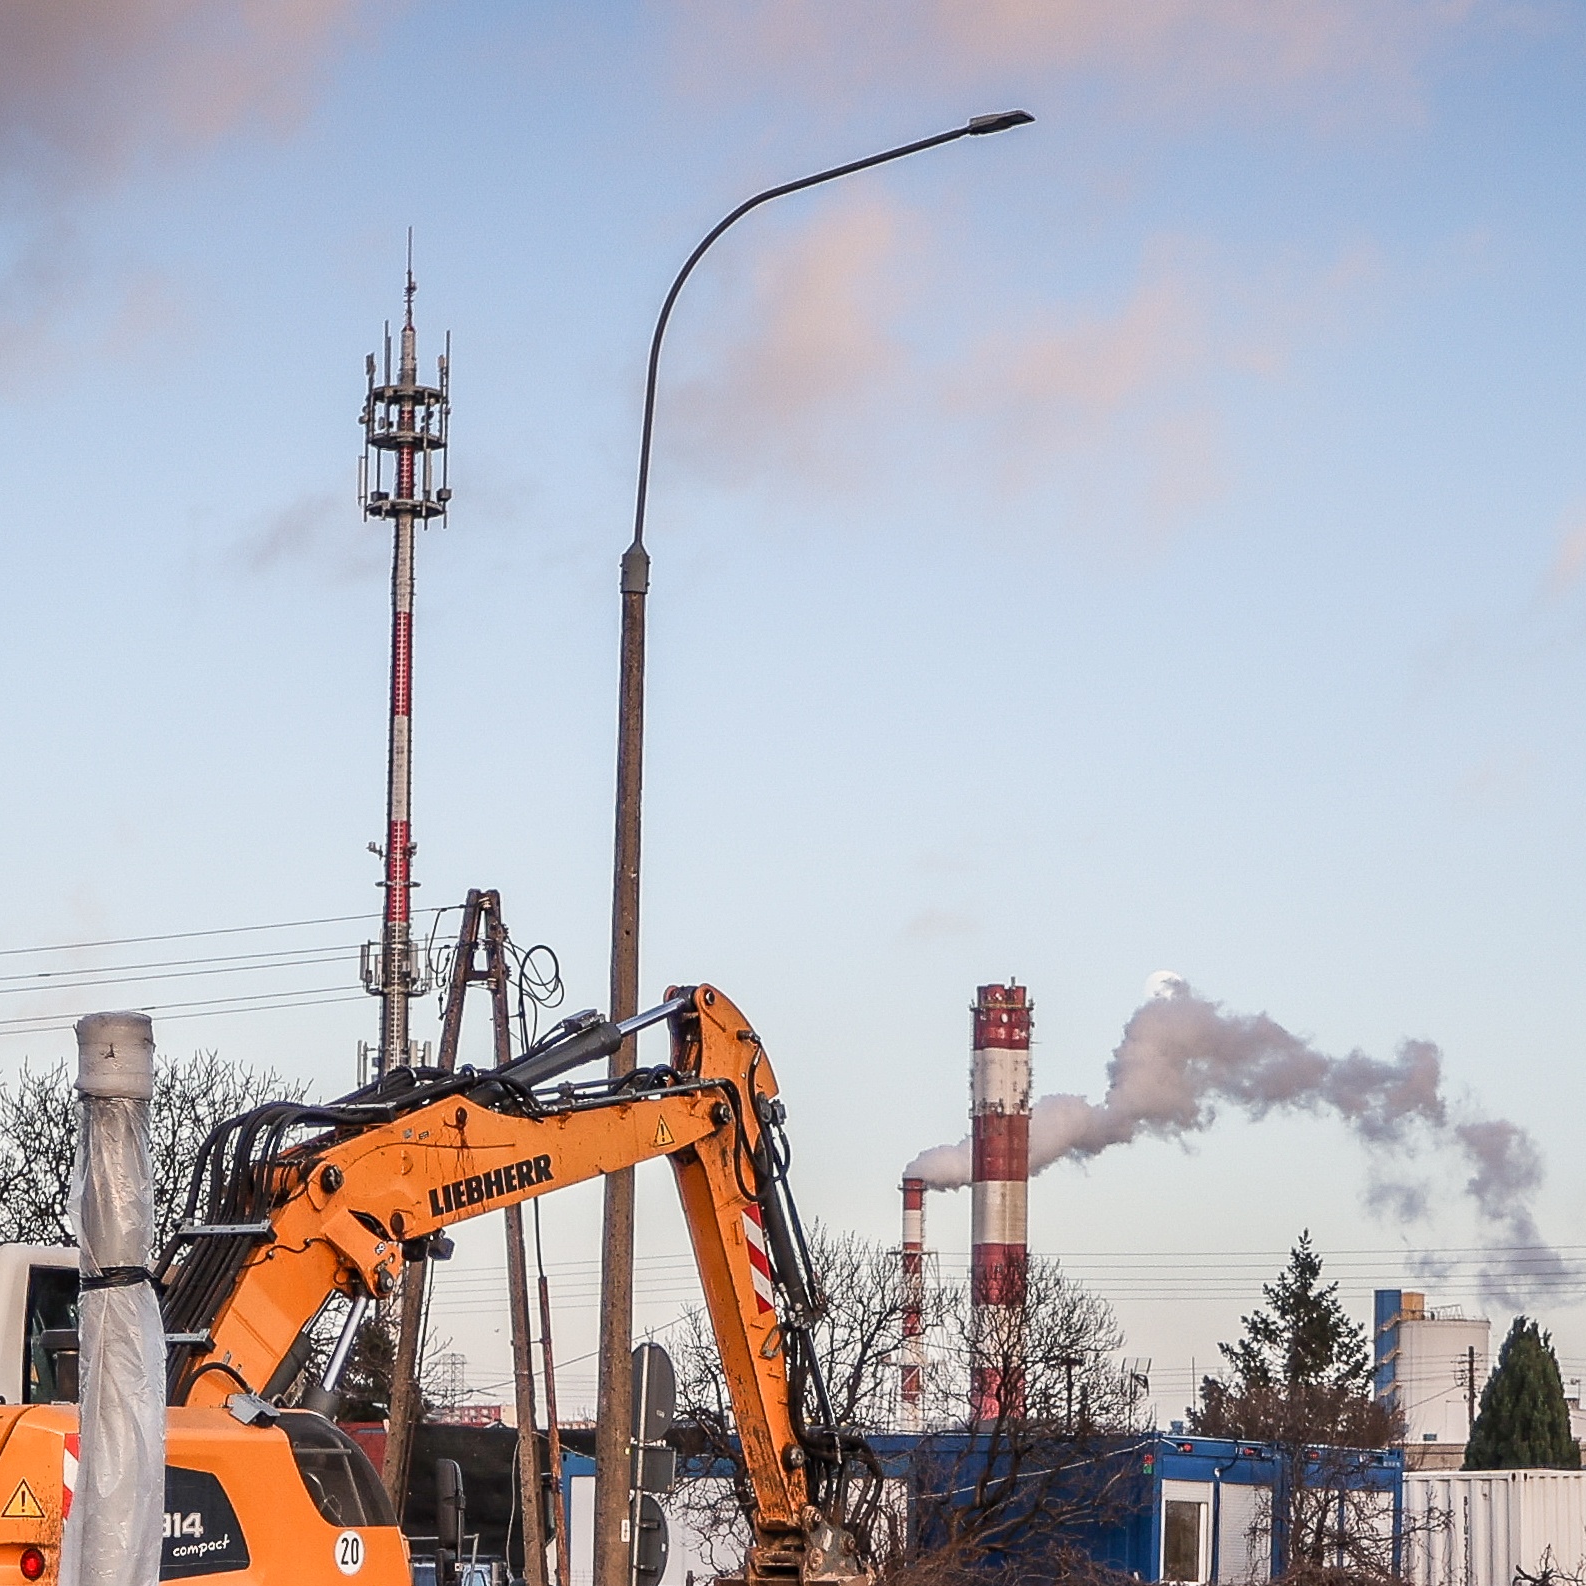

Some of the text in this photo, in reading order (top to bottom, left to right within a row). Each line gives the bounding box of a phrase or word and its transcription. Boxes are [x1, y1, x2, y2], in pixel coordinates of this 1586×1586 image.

[428, 1153, 554, 1218] LIEBHERR
[172, 1533, 230, 1557] compact
[341, 1537, 359, 1565] 20
